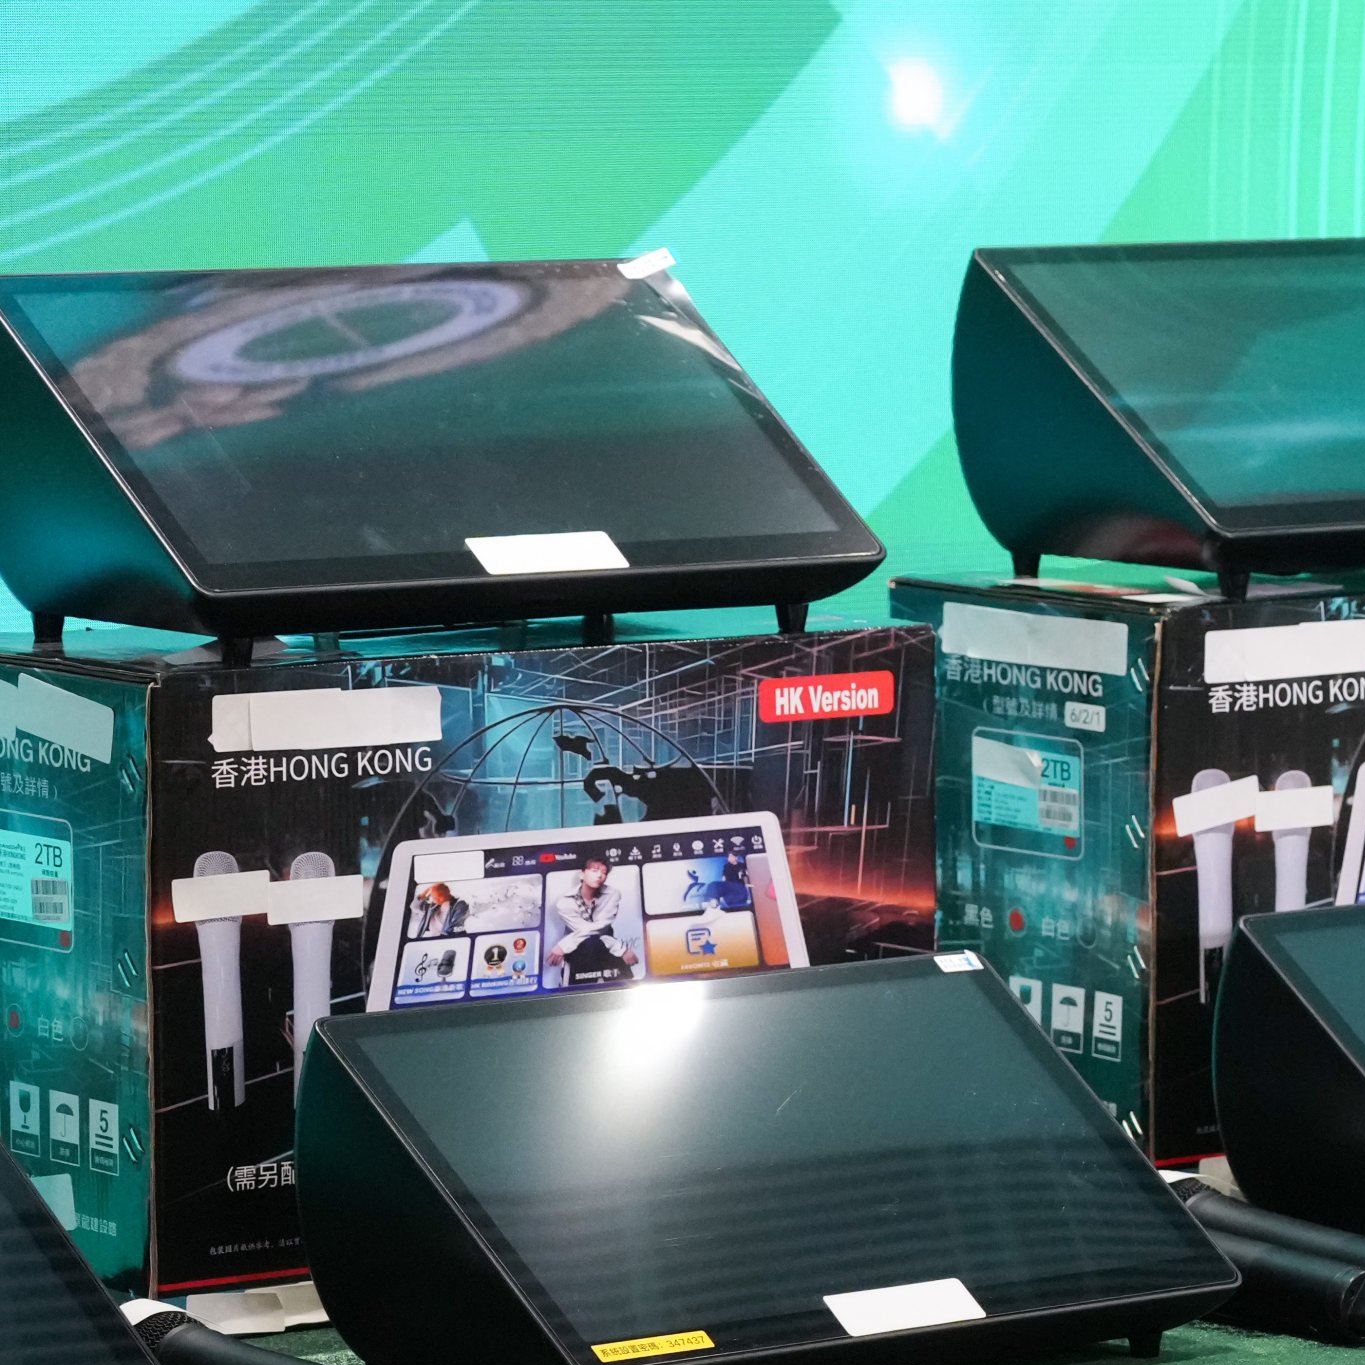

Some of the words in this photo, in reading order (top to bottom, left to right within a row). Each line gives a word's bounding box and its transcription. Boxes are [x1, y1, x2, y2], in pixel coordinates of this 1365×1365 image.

[1046, 669, 1103, 697] KONG
[1208, 678, 1326, 715] 香港HONG
[775, 689, 806, 715] HK
[809, 683, 880, 713] Version
[1070, 709, 1101, 727] 6/2/1
[38, 741, 91, 772] KONG
[210, 753, 349, 790] 香港HONG
[355, 745, 434, 777] KONG
[1041, 757, 1072, 781] 2TB
[35, 842, 63, 868] 2TB
[1103, 1001, 1113, 1023] 5
[37, 1014, 64, 1042] 白色
[99, 1109, 109, 1134] 5
[665, 1335, 705, 1349] 347437
